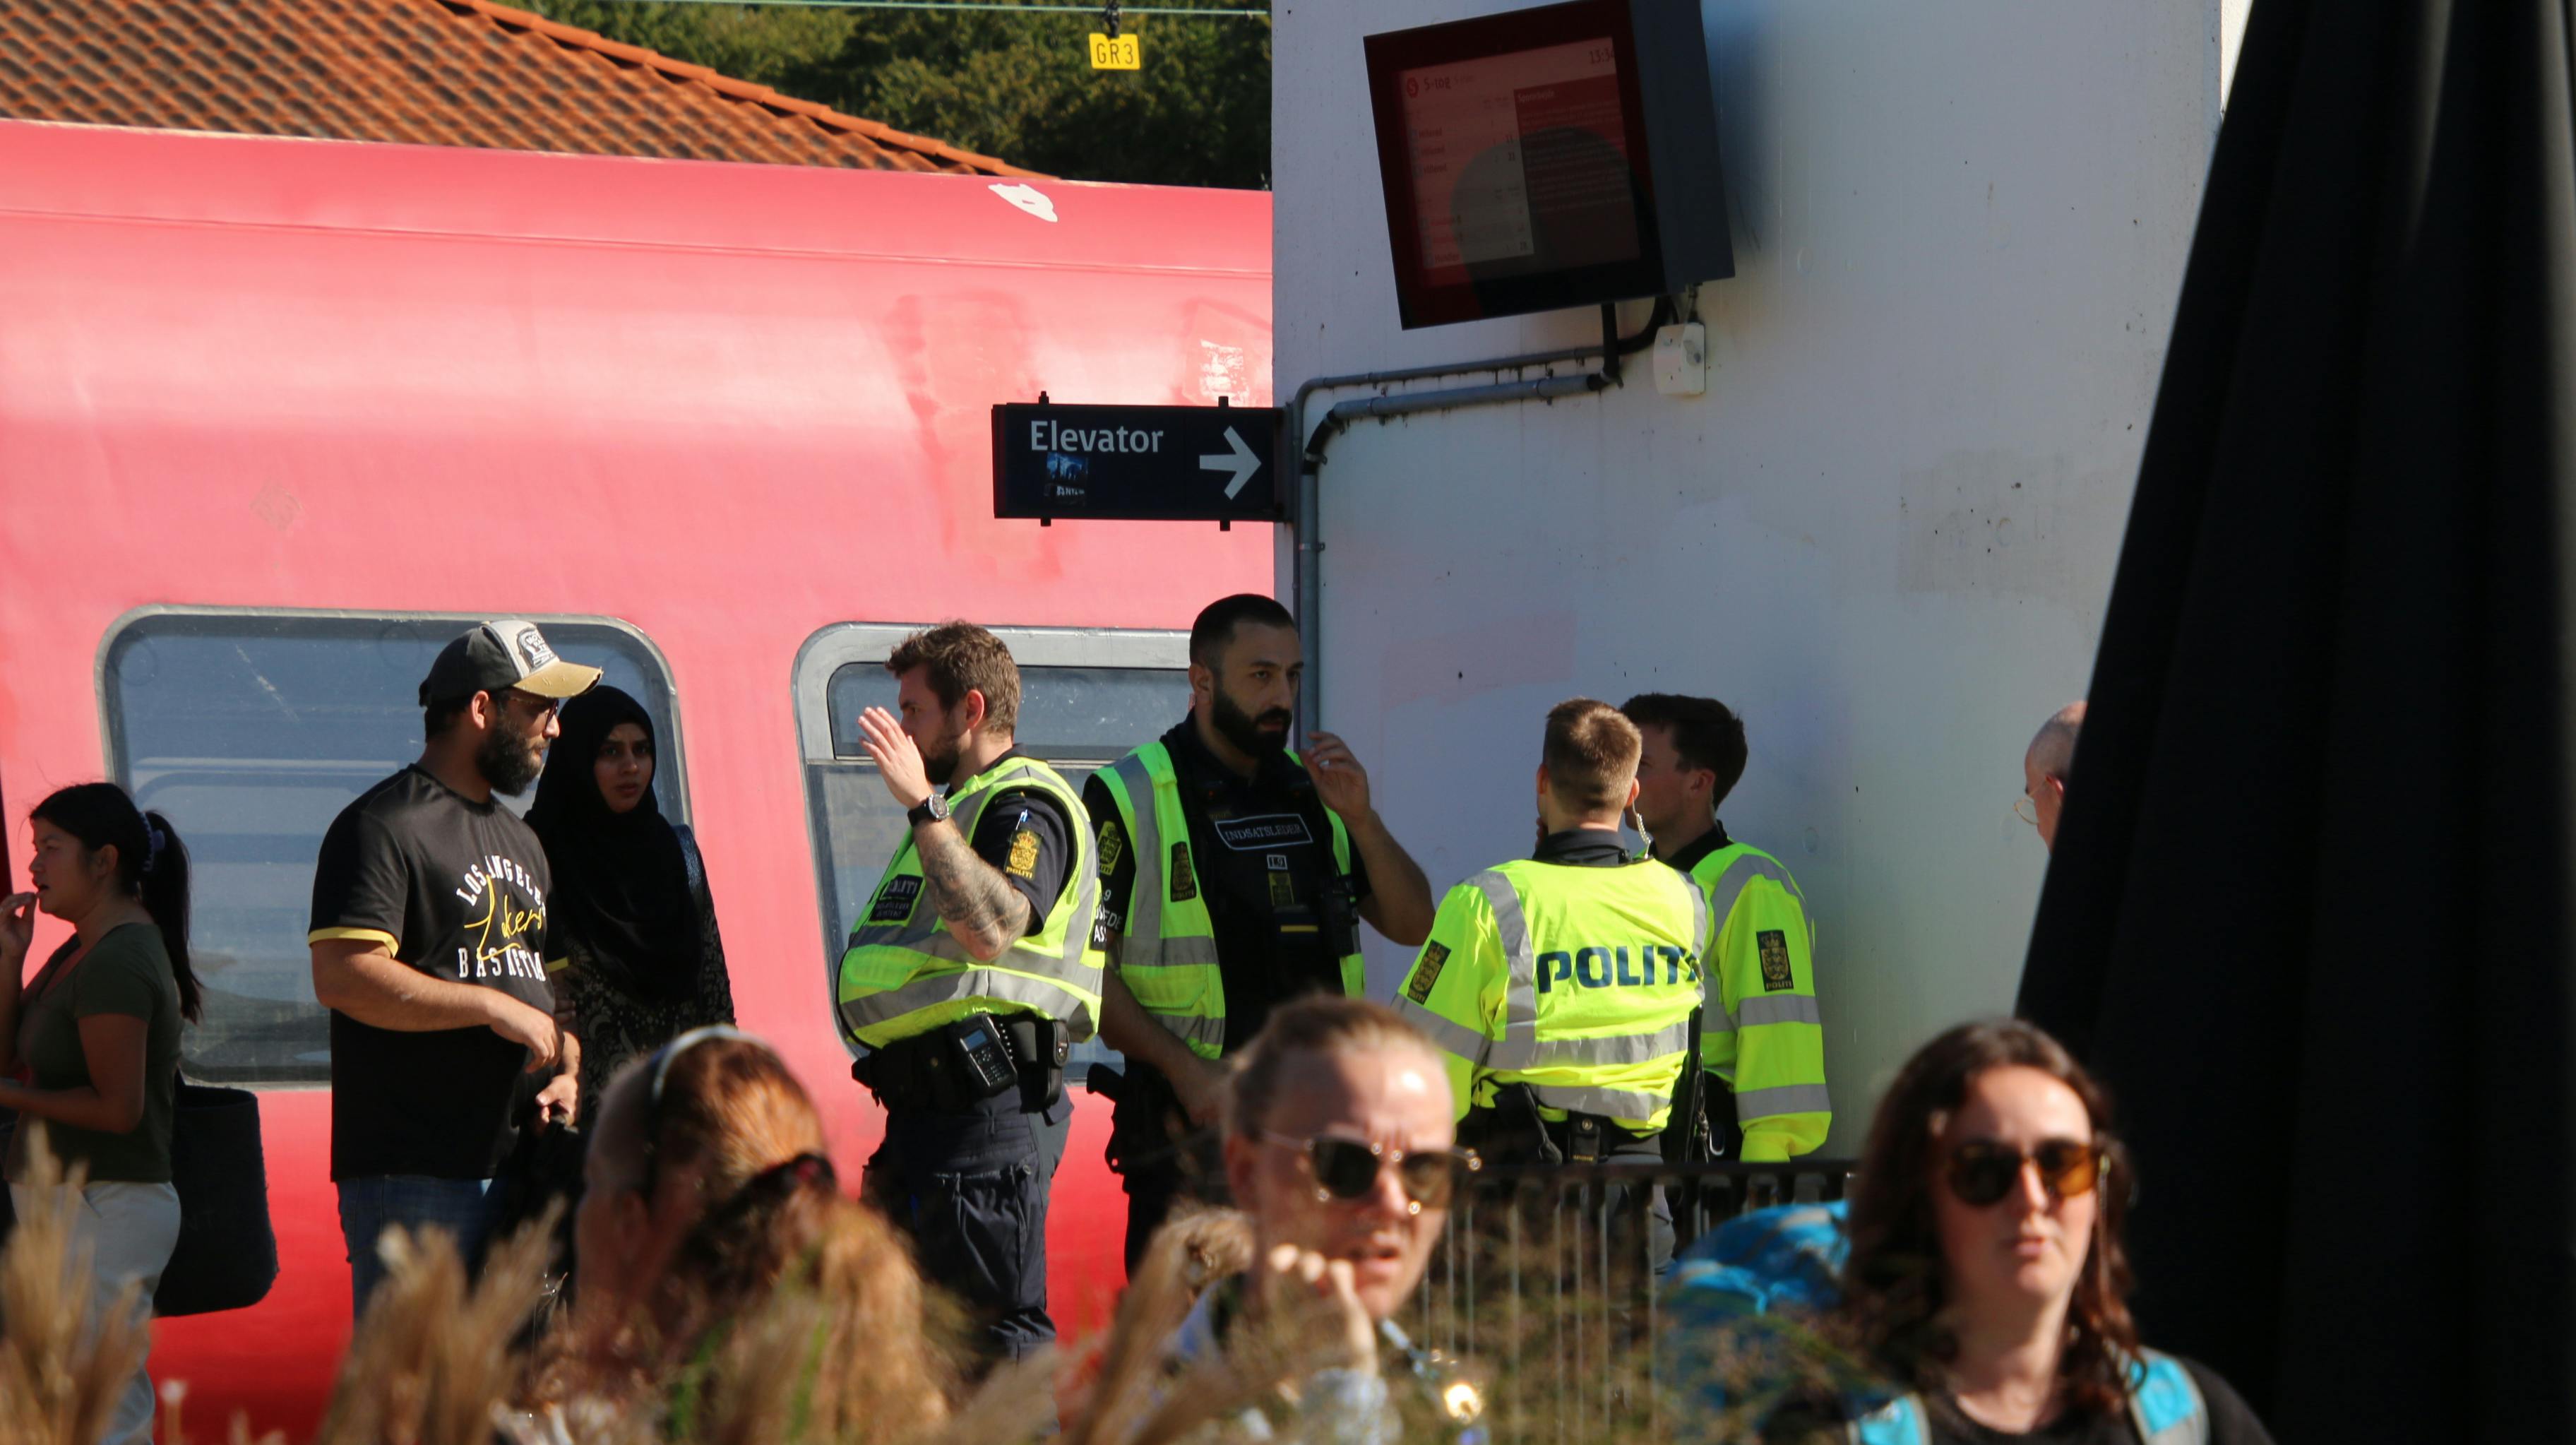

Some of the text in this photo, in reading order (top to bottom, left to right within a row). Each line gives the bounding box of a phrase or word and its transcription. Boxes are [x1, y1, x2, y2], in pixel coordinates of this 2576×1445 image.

[1097, 43, 1133, 64] GR3
[1424, 76, 1452, 92] S-tog
[1031, 420, 1164, 453] Elevator
[1224, 823, 1302, 841] INDSATSLEDER
[1006, 866, 1032, 879] POLITI
[456, 864, 487, 907] LOS
[1766, 980, 1792, 990] POLITI
